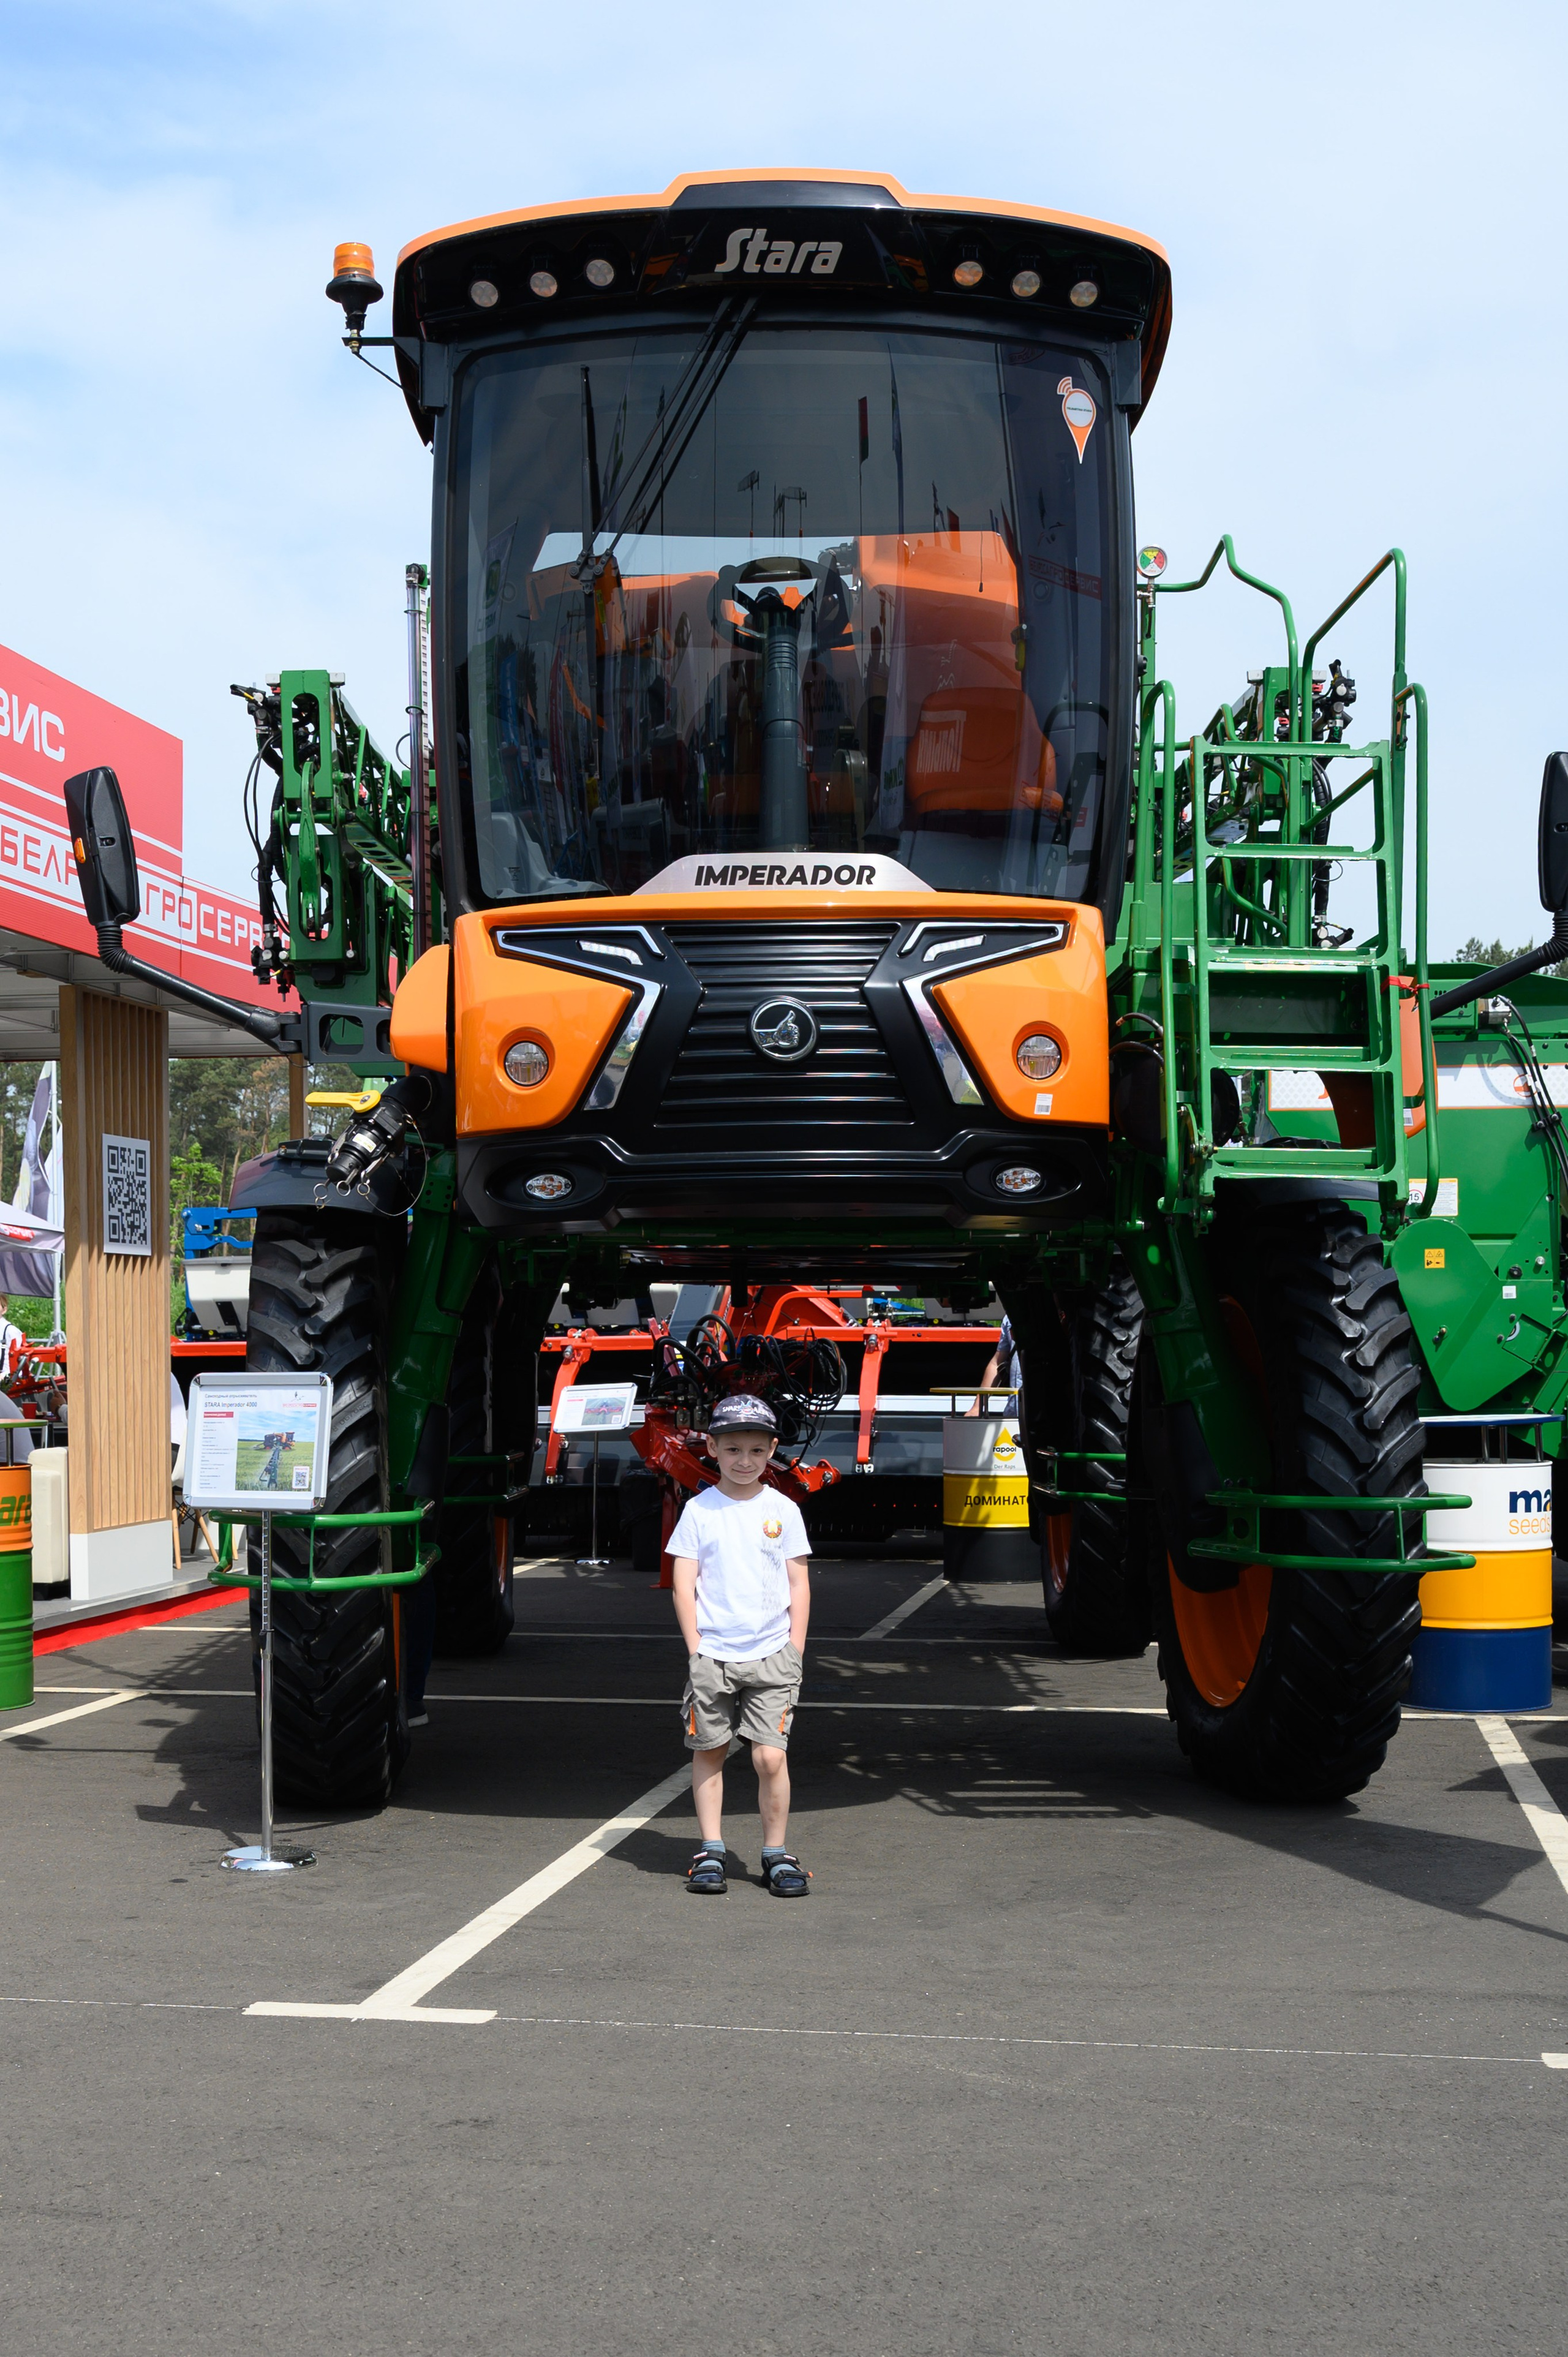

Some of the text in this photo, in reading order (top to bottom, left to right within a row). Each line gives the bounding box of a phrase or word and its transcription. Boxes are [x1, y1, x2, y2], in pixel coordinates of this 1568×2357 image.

[714, 228, 843, 274] Stara
[695, 864, 876, 886] IMPERADOR
[1409, 1193, 1419, 1201] 15
[964, 1495, 1029, 1507] ДОМИНАТ
[1509, 1514, 1550, 1535] seeds
